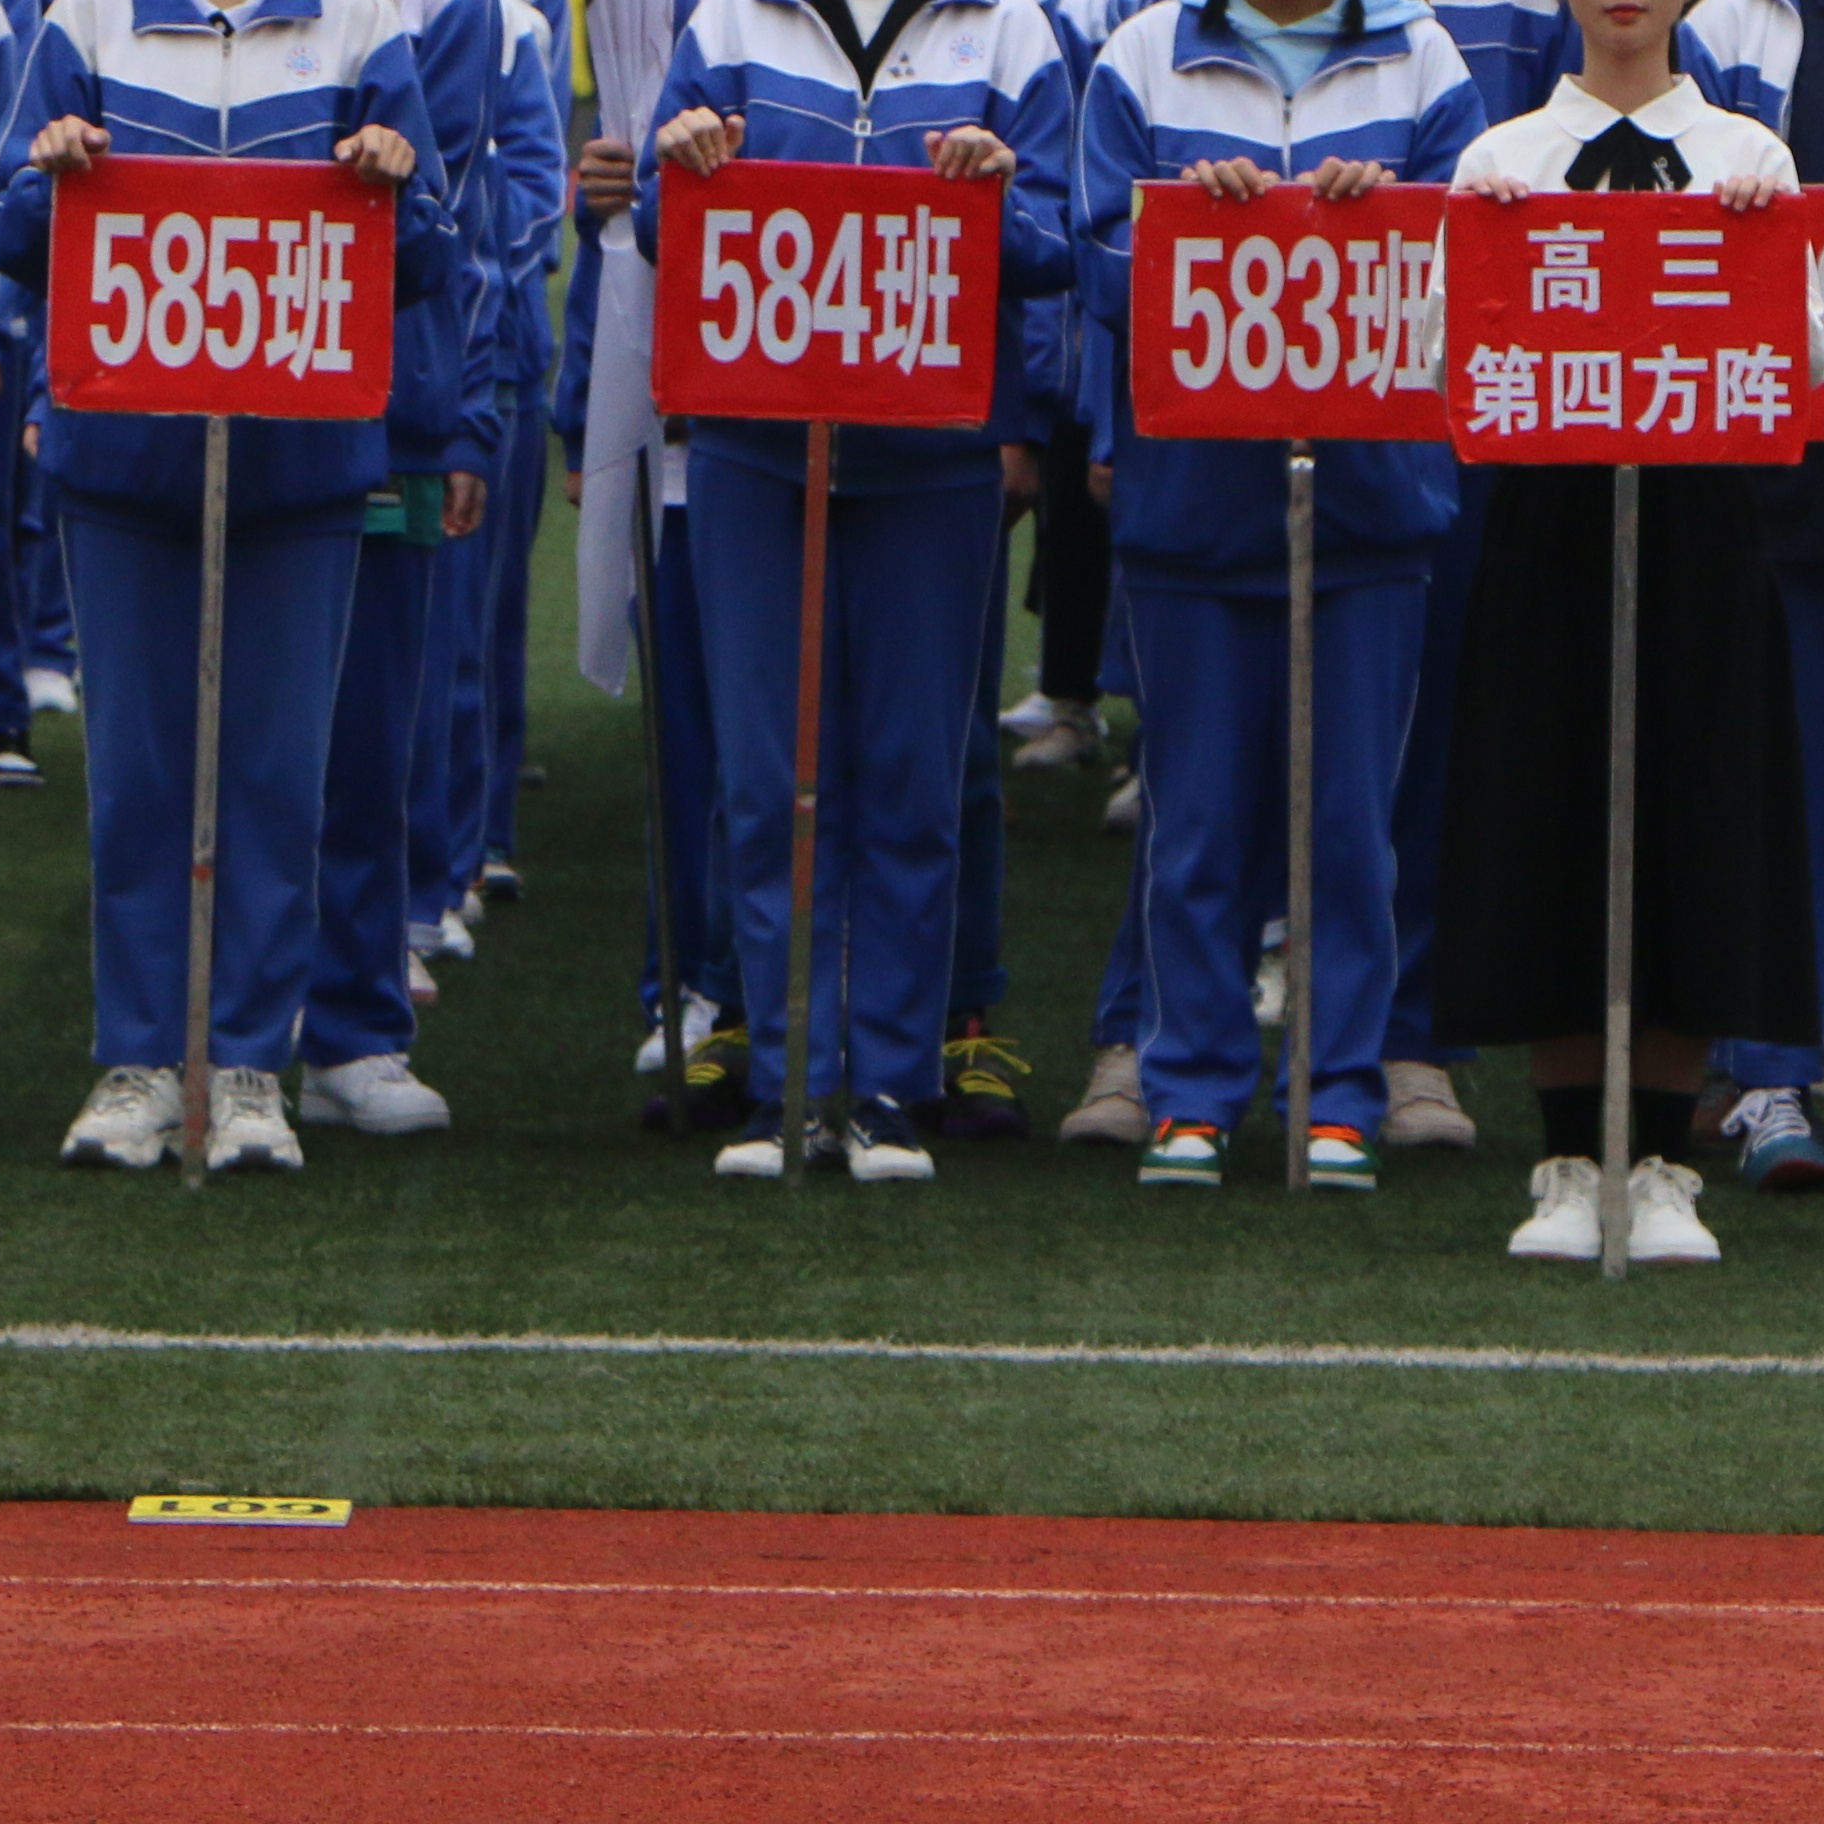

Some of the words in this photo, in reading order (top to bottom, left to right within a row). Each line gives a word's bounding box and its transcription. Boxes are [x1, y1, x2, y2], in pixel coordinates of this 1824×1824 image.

[90, 211, 354, 380] 585班
[701, 206, 961, 374] 584班
[1172, 230, 1437, 398] 583班
[1465, 343, 1793, 436] 第四方阵
